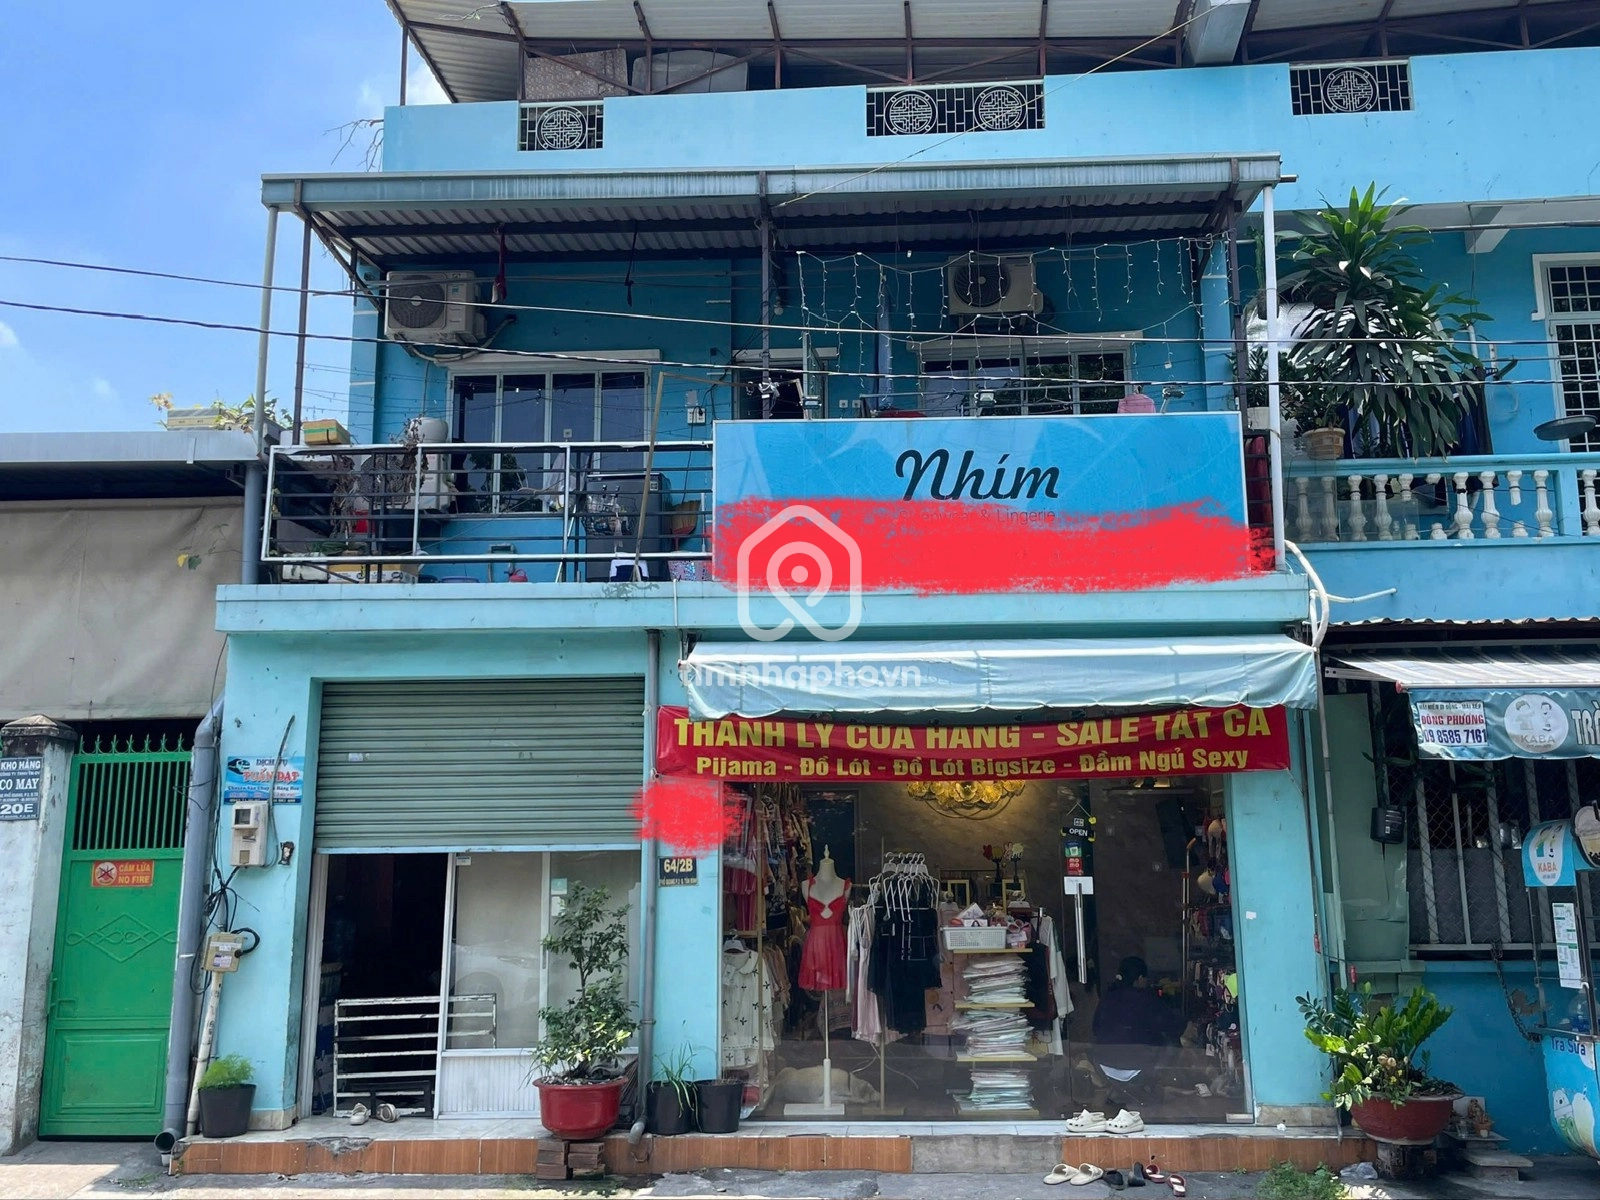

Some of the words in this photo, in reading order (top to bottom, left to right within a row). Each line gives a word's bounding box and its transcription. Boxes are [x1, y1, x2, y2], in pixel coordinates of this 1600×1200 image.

[895, 448, 1060, 501] Nhím
[674, 718, 785, 747] THANH
[1057, 717, 1140, 747] SALE
[1436, 729, 1461, 743] 8585
[1464, 729, 1487, 743] 7161
[1520, 734, 1556, 744] KABA
[1, 761, 17, 770] KHO
[696, 756, 777, 777] Pijama
[800, 755, 829, 776] Đồ
[836, 757, 871, 776] Lót
[893, 756, 923, 776] Đồ
[930, 758, 965, 776] Lót
[971, 758, 1056, 777] Bigsize
[1079, 750, 1132, 773] Đầm
[1139, 746, 1185, 772] Ngủ
[1192, 748, 1248, 769] Sexy
[15, 778, 39, 790] MAY
[0, 803, 33, 815] 20E
[1069, 828, 1088, 837] OPEN
[664, 858, 693, 873] 64/2B
[1537, 862, 1557, 872] KABA
[118, 875, 130, 884] NO
[131, 875, 150, 884] FIRE
